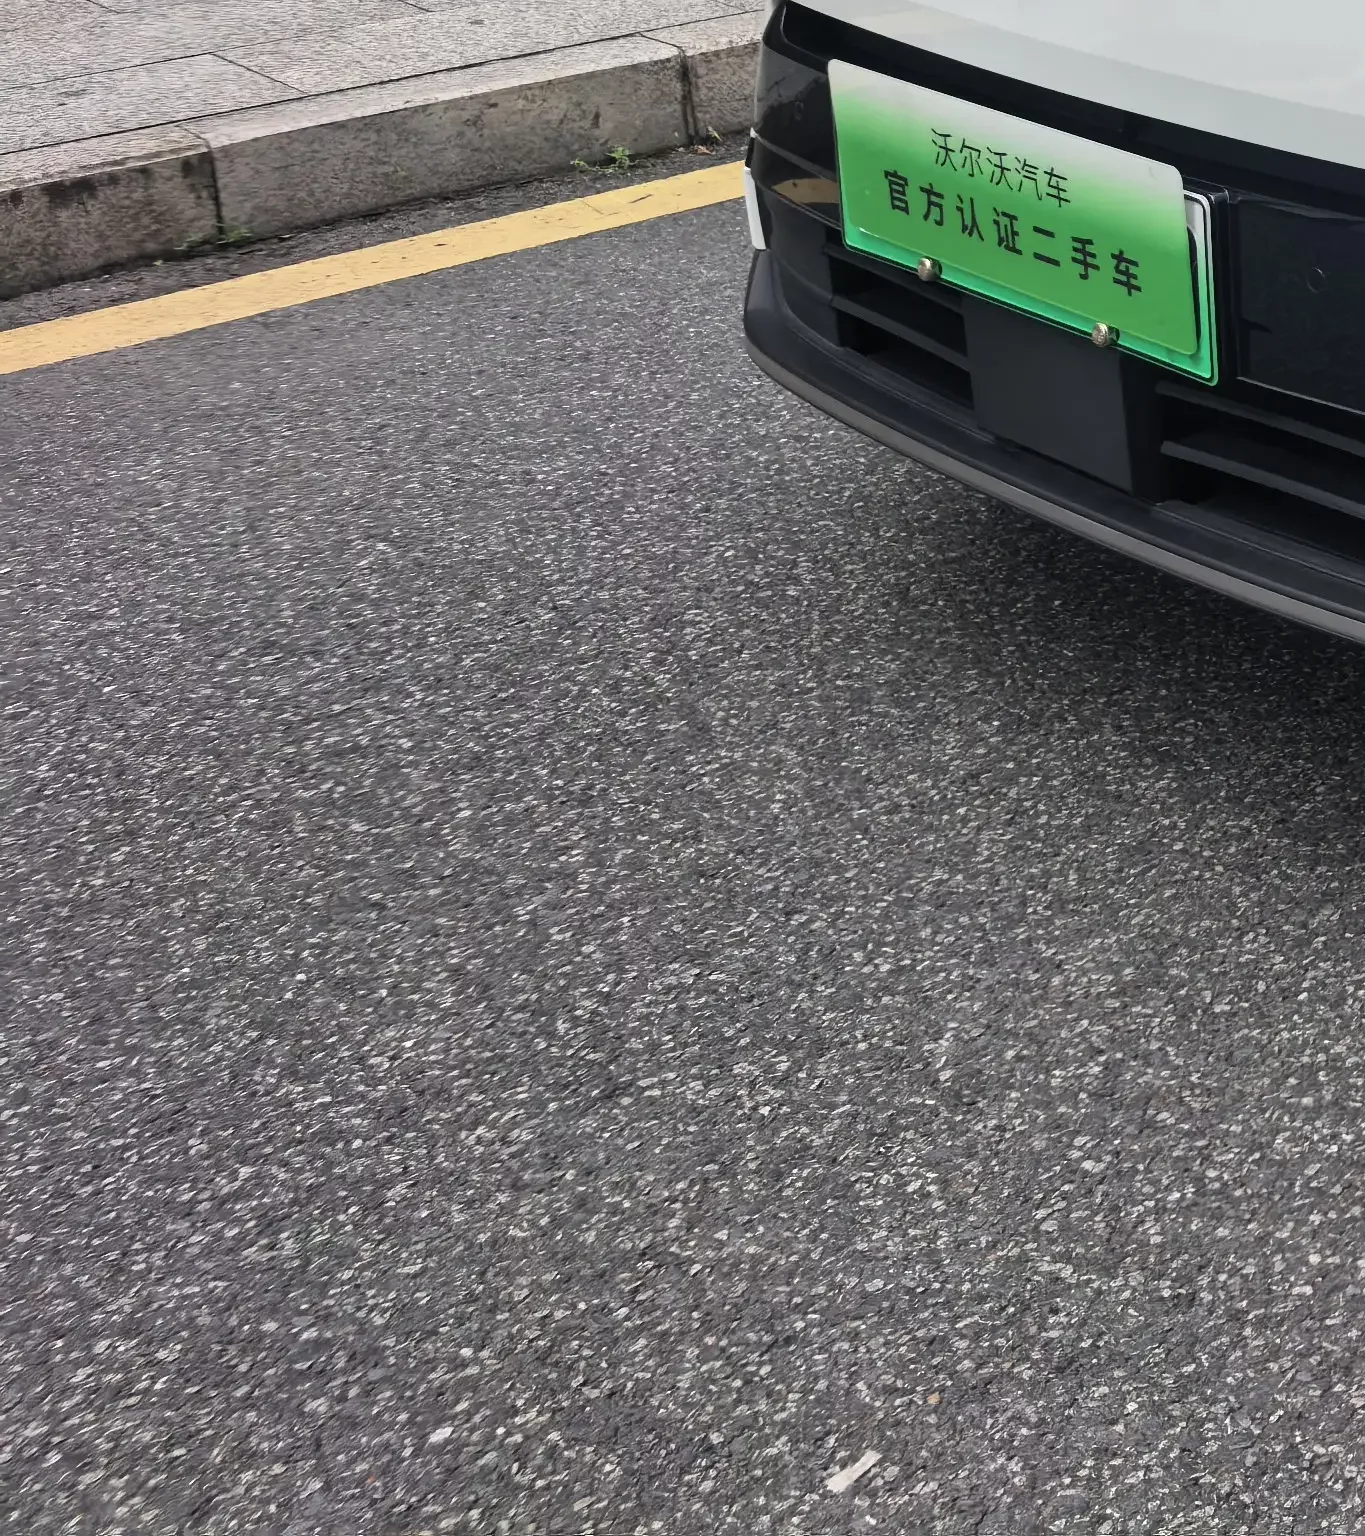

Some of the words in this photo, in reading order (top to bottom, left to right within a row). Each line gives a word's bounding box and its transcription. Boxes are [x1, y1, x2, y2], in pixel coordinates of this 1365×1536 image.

[931, 127, 1071, 208] 沃尔沃汽车
[883, 168, 1143, 298] 官方认证二手车
